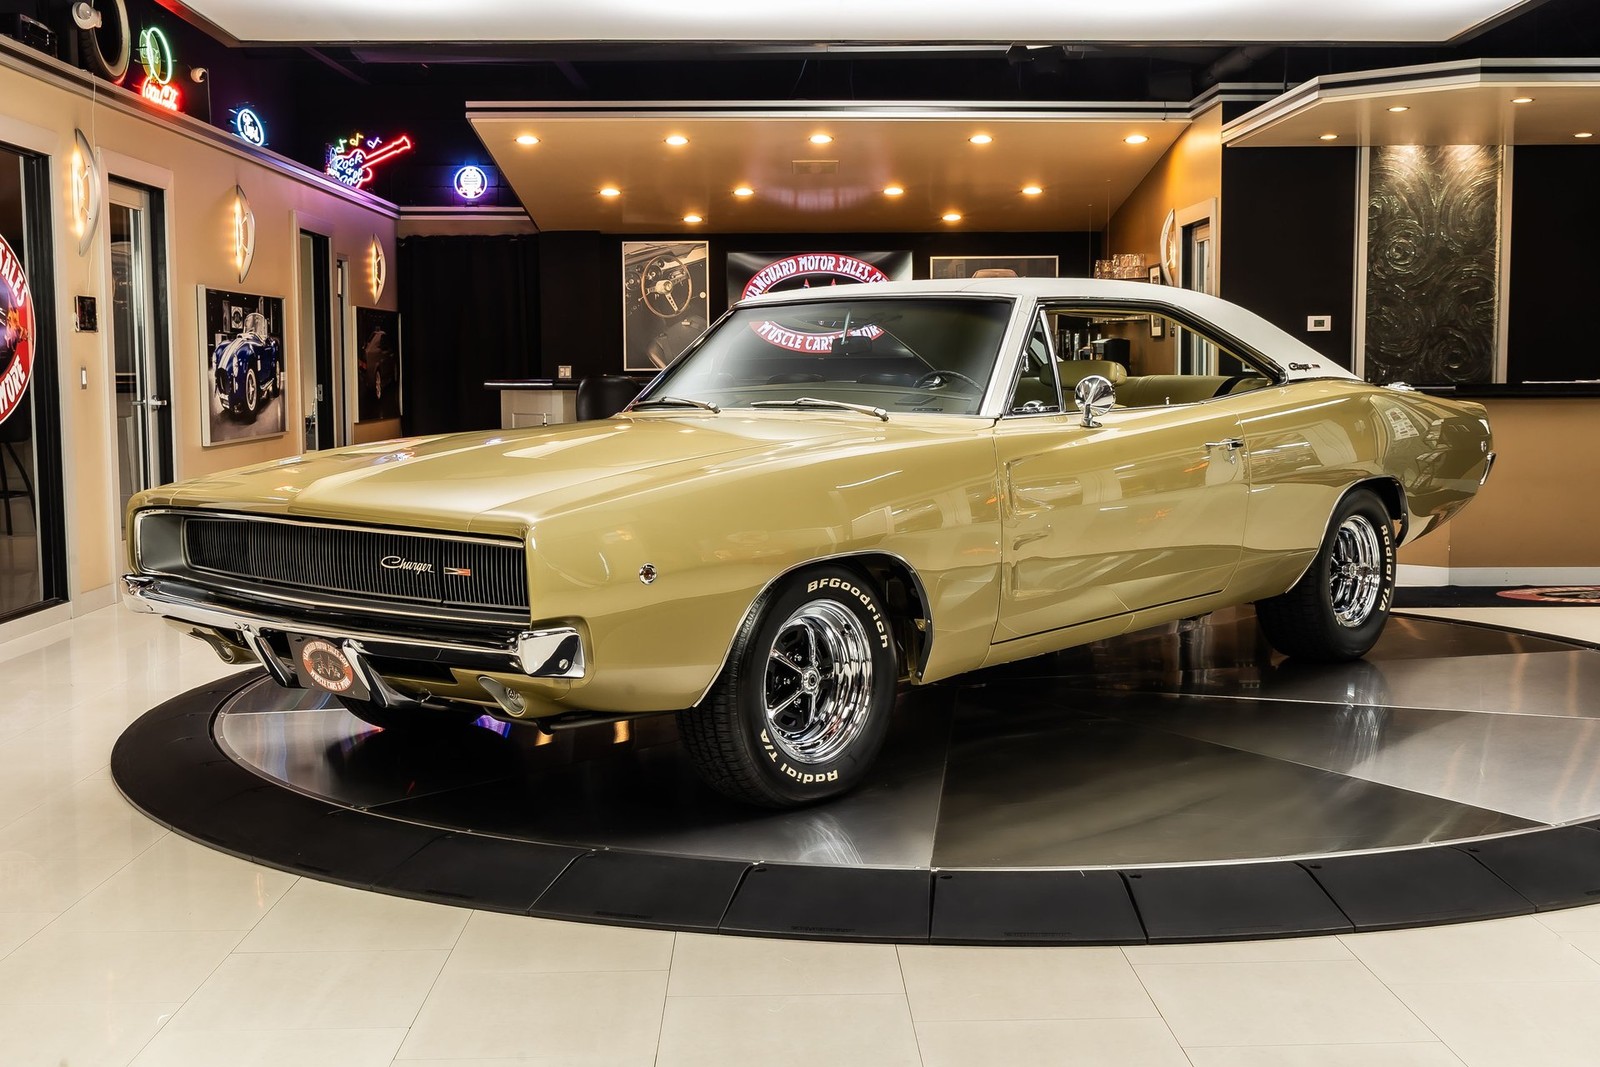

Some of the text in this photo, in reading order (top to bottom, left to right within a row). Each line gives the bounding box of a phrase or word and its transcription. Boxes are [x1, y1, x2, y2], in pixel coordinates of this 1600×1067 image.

[333, 151, 363, 170] Rock
[797, 255, 836, 271] MOTOR
[757, 321, 803, 349] MUSCLE
[381, 555, 435, 576] Charger
[1379, 524, 1392, 612] Radial T/A
[807, 577, 889, 649] BFGoodrich
[759, 727, 839, 784] Radial T/A
